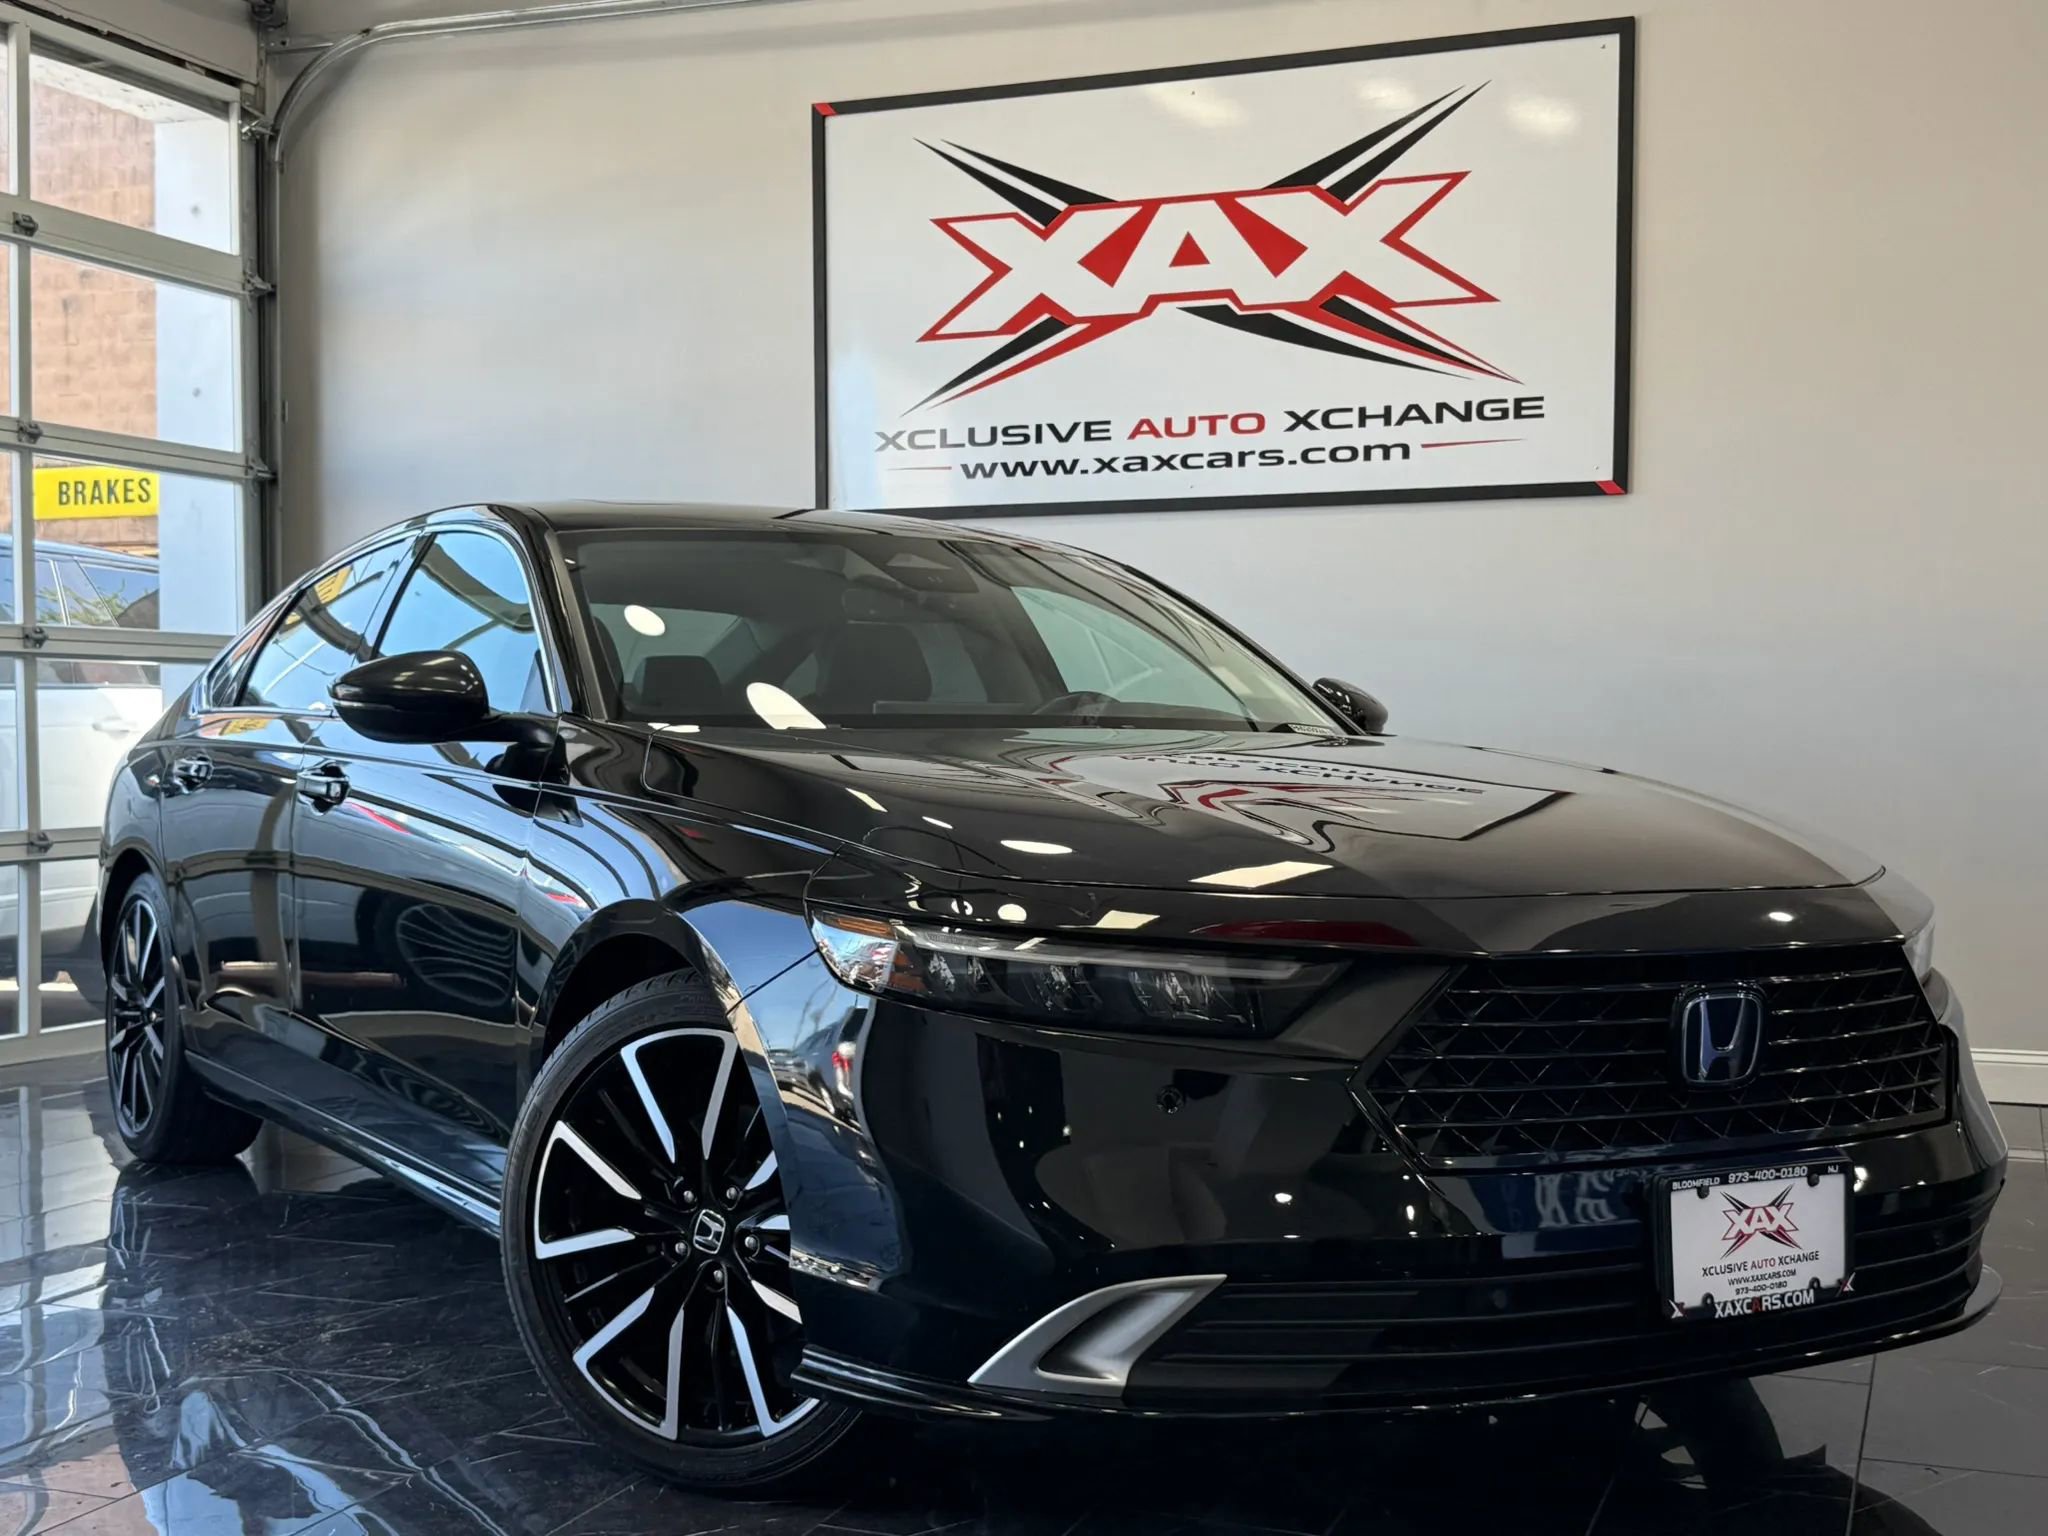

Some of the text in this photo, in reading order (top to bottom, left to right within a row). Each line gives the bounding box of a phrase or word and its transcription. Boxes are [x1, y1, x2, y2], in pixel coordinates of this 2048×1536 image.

[916, 171, 1500, 342] XAX
[874, 396, 1545, 452] XCLUSIVE AUTO XCHANGE
[960, 442, 1411, 479] www.xaxcars.com
[58, 477, 152, 506] BRAKES
[1672, 1165, 1840, 1190] BLOOMFIELD 973-400-0180 NJ
[1722, 1202, 1799, 1240] XAX
[1701, 1251, 1820, 1277] XCLUSIVE AUTO XCHANGE
[1728, 1268, 1797, 1286] WWW.XAXCARS.COM
[1735, 1281, 1788, 1295] 973-400-0180
[1715, 1289, 1815, 1319] XAXCARS.COM
